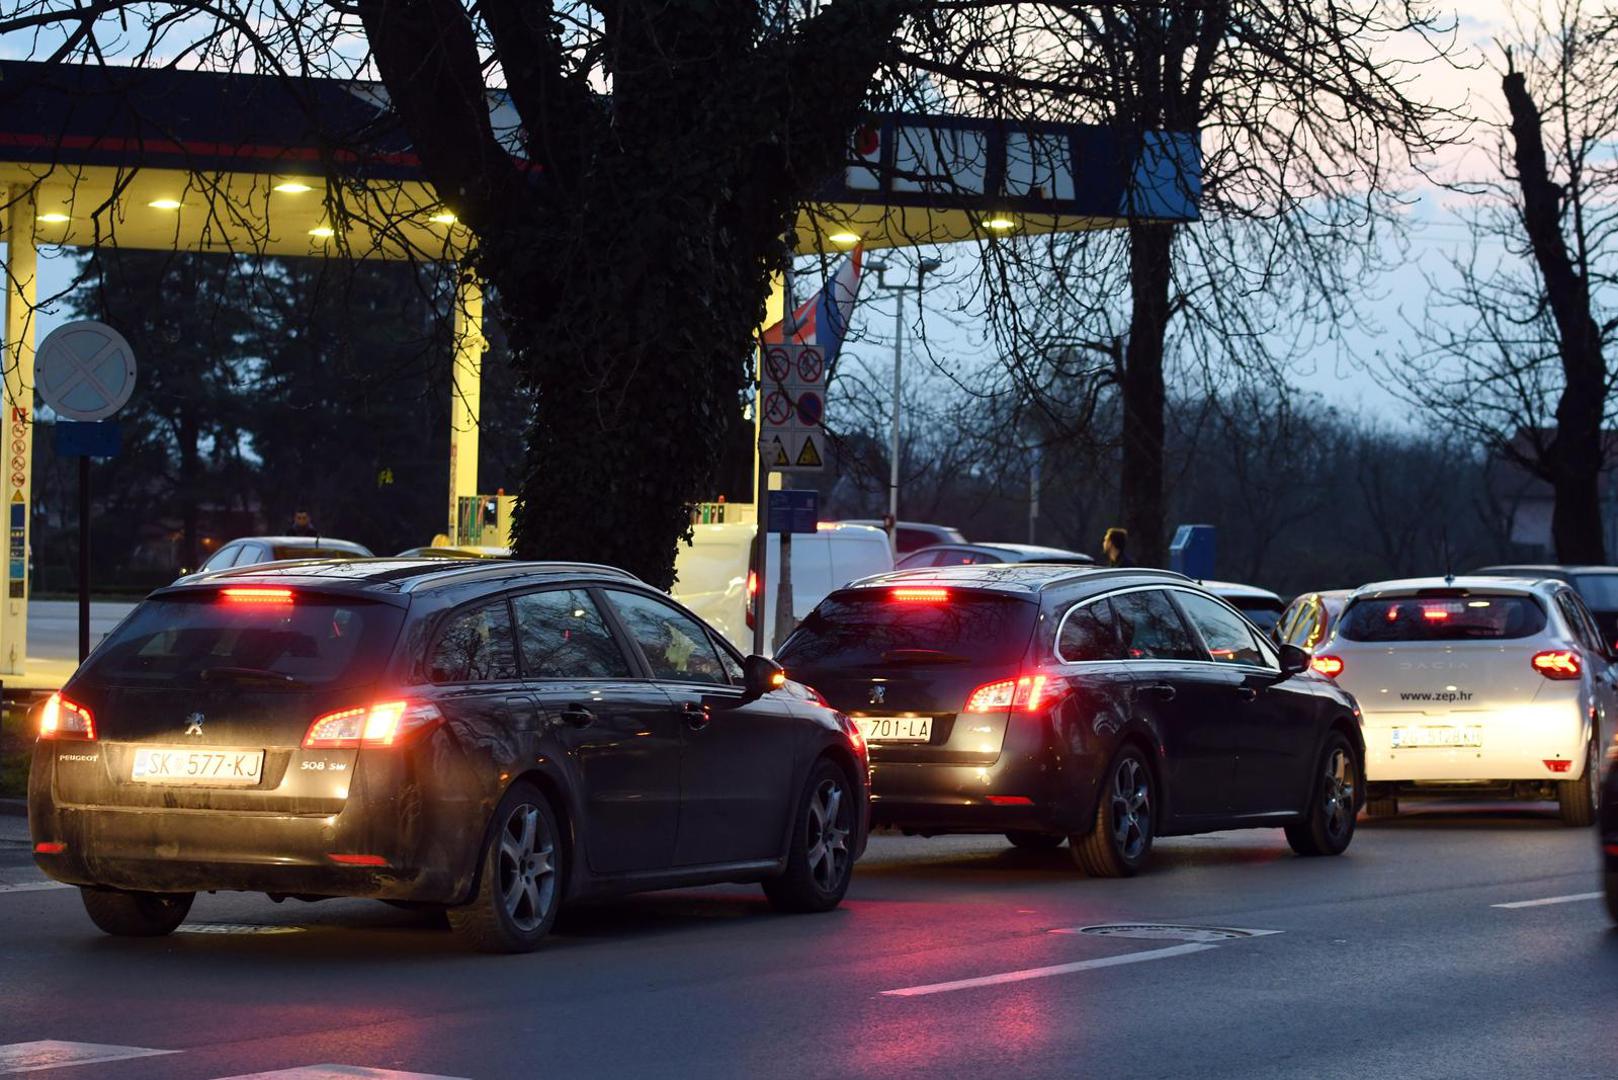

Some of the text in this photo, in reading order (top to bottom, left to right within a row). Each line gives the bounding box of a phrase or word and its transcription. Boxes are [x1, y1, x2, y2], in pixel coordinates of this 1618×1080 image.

[1400, 691, 1473, 702] www.zep.hr
[59, 754, 98, 762] PEUGEOT
[149, 753, 171, 775] SK
[300, 761, 325, 770] 508
